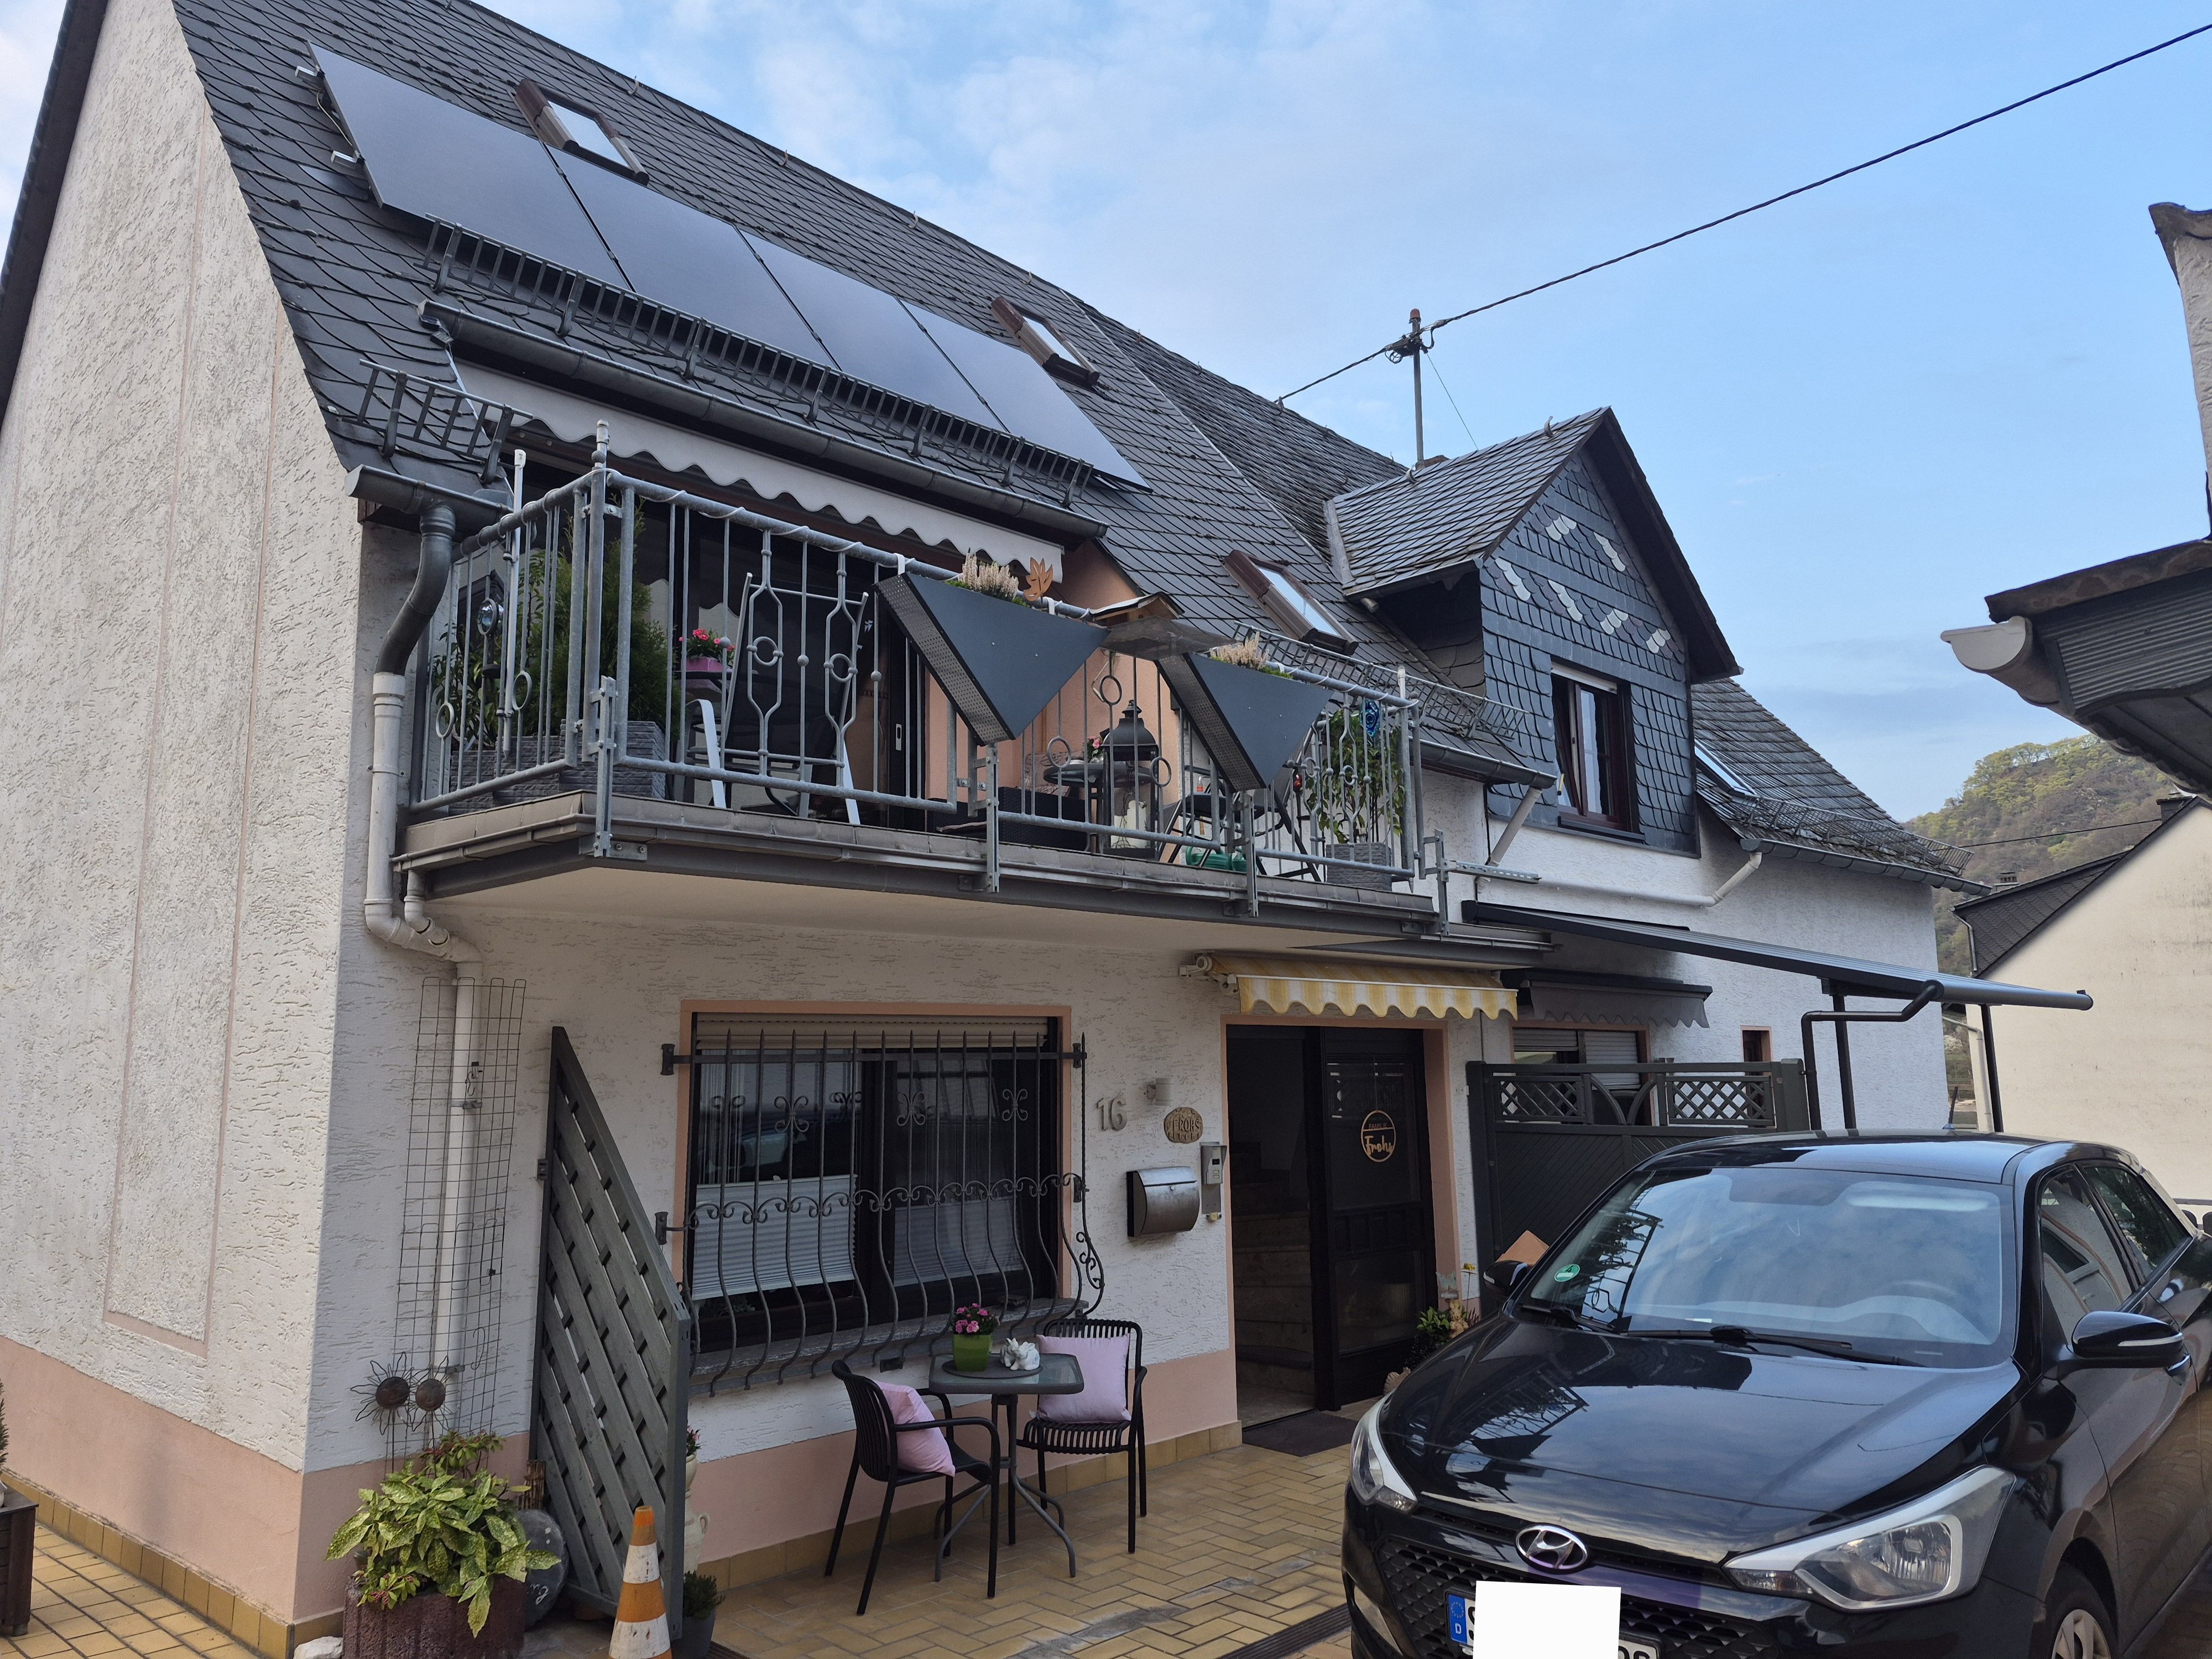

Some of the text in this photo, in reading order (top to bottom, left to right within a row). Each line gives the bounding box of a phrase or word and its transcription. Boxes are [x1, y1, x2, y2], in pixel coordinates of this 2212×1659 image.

[1097, 1097, 1127, 1131] 16
[1566, 1265, 1574, 1273] 4
[1454, 1623, 1462, 1635] D
